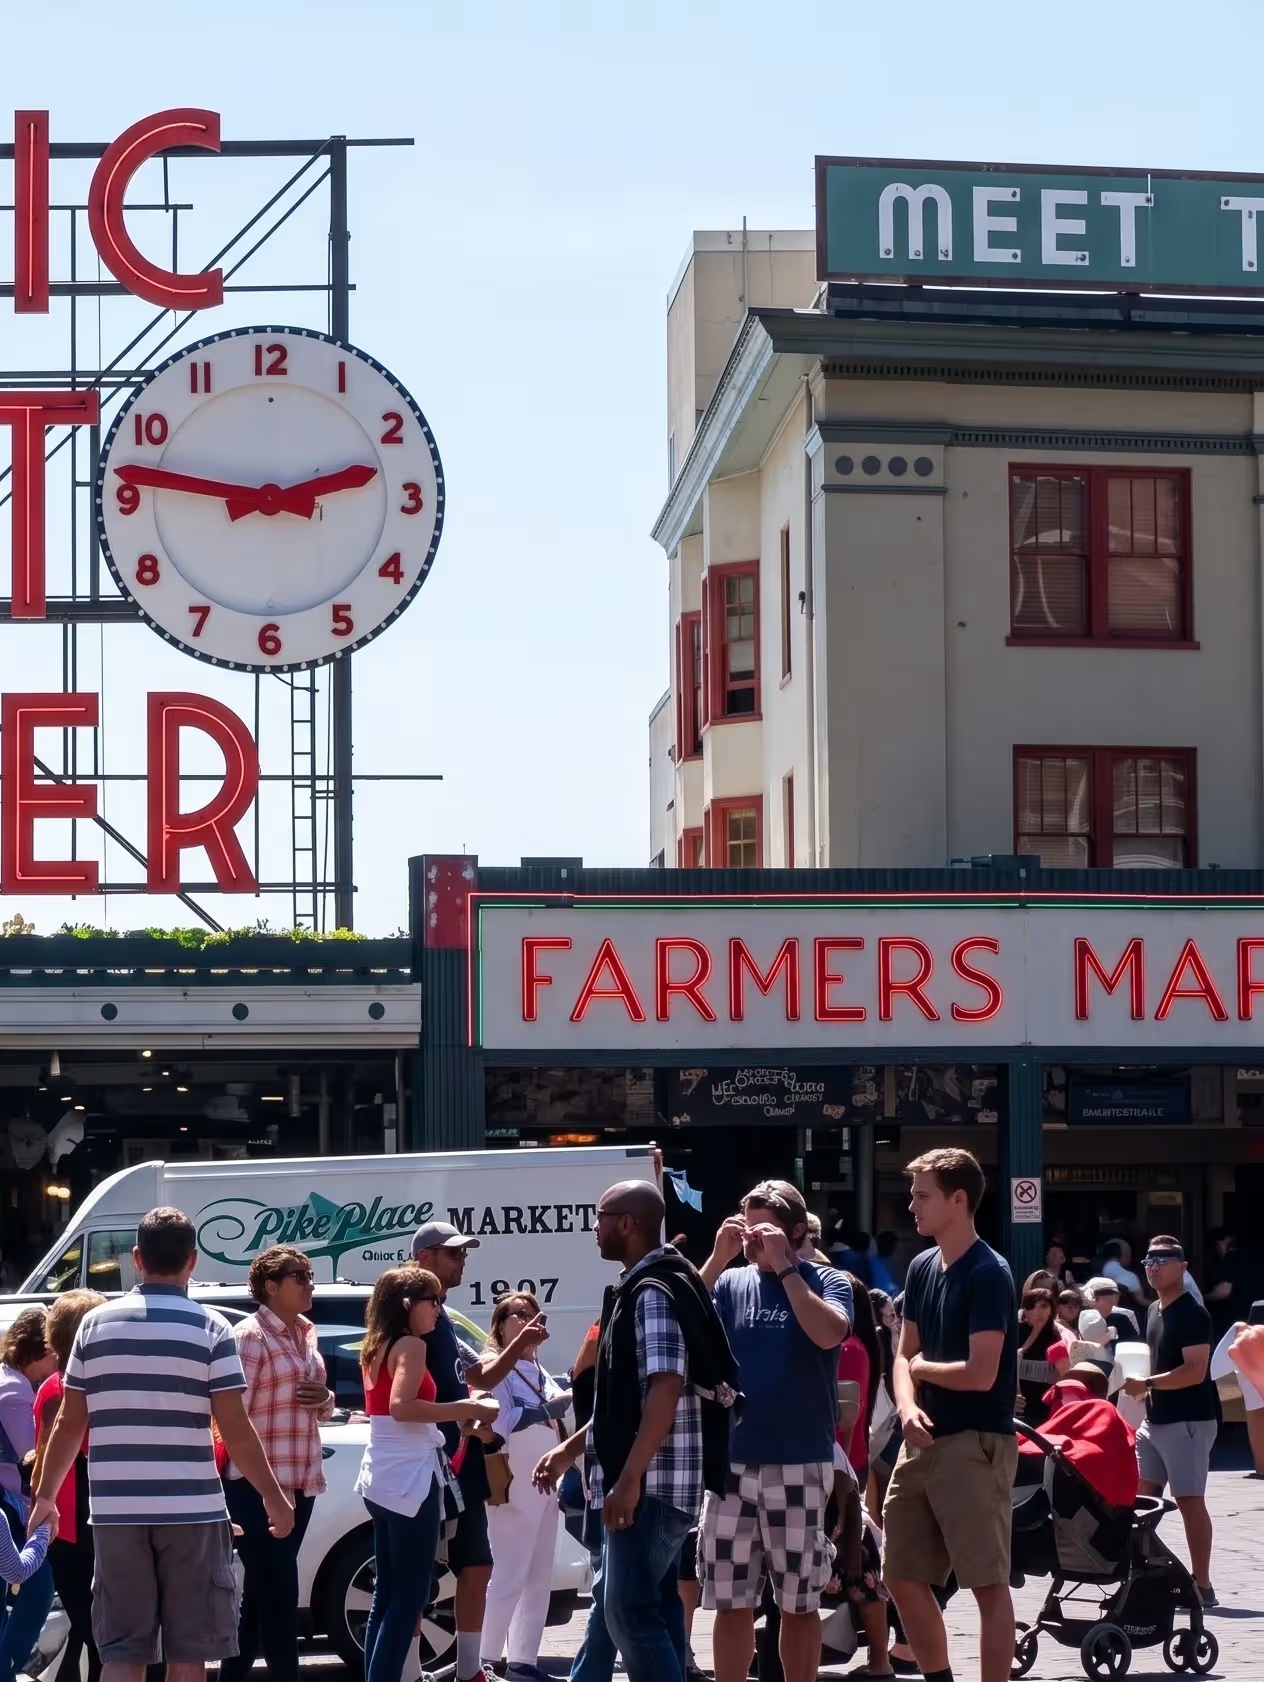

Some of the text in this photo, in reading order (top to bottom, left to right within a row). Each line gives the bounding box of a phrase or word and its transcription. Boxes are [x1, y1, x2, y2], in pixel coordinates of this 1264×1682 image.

[878, 182, 1155, 268] MEET
[254, 344, 288, 376] 12
[190, 361, 211, 394] 11
[338, 361, 346, 393] 1
[134, 413, 168, 446] 10
[380, 412, 404, 444] 2
[116, 482, 141, 515] 9
[400, 482, 423, 515] 3
[135, 553, 161, 586] 8
[378, 552, 404, 585] 4
[188, 605, 211, 638] 7
[330, 604, 354, 636] 5
[257, 623, 282, 656] 6
[521, 935, 1004, 1022] FARMERS
[243, 1195, 434, 1253] Pike Place
[447, 1203, 597, 1236] MARKET
